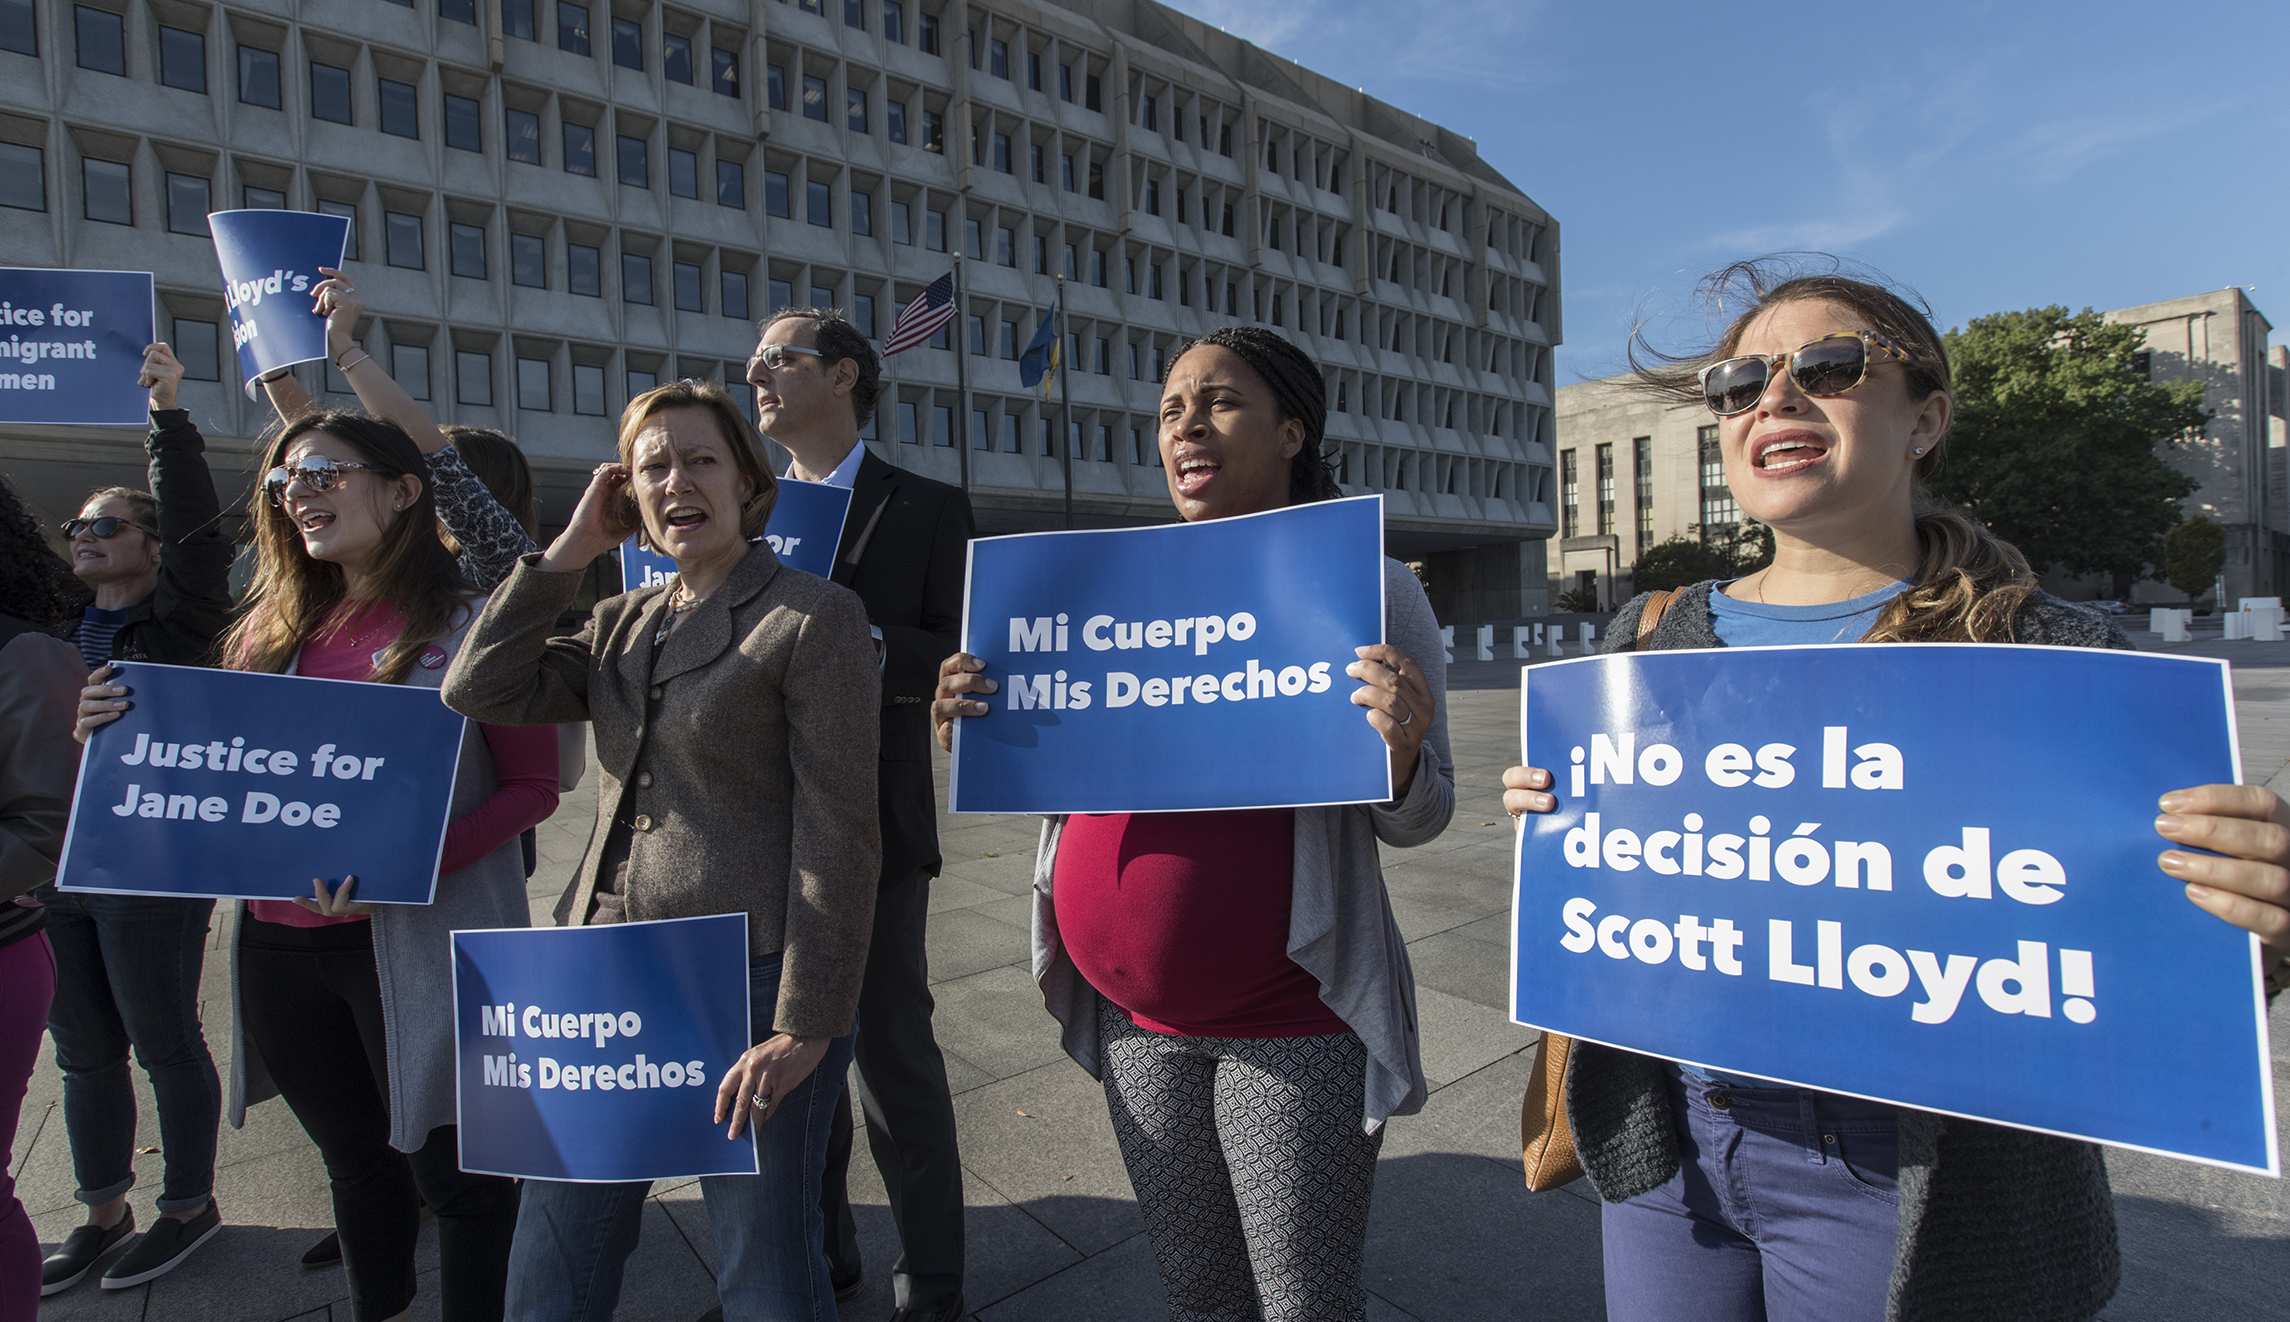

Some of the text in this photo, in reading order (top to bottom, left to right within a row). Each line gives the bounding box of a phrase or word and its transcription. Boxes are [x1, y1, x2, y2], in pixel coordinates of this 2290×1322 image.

[50, 302, 94, 328] for
[1009, 611, 1257, 656] Mi Cuerpo
[1007, 659, 1332, 711] Mis Derechos
[120, 733, 385, 781] Justice for
[1570, 726, 1904, 798] ¡No es la
[111, 783, 341, 829] Jane Doe
[1563, 811, 2067, 905] decisión de
[1560, 897, 2097, 1025] Scott Lloyd!
[482, 1002, 642, 1048] Mi Cuerpo
[483, 1053, 706, 1091] Mis Derechos
